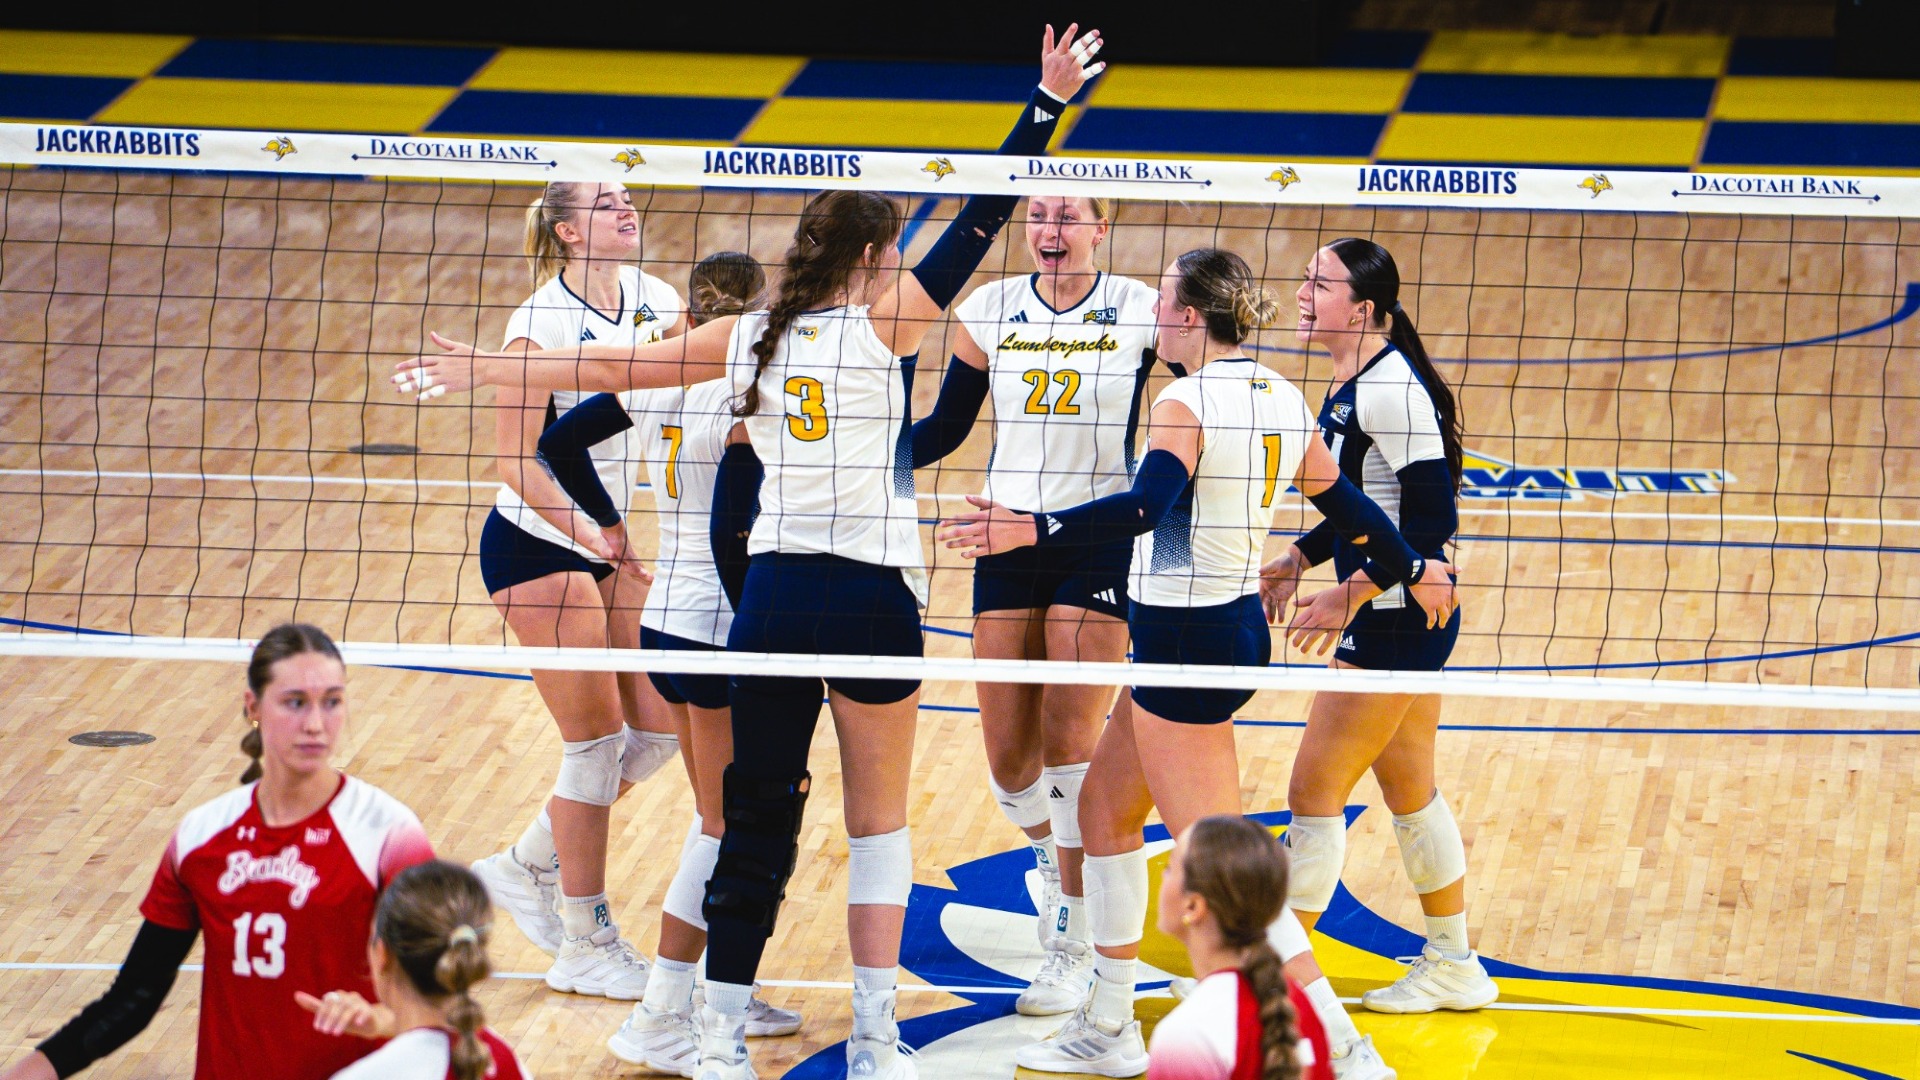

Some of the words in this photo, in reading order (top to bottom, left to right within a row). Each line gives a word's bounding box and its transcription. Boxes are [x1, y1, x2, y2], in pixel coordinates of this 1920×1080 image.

[35, 128, 201, 157] JACKRABBITS
[370, 138, 473, 159] DACOTAH
[479, 142, 539, 161] BANK
[703, 150, 862, 178] JACKRABBITS
[1027, 158, 1128, 179] DACOTAH
[1135, 162, 1194, 180] BANK
[1357, 167, 1518, 195] JACKRABBITS
[1690, 174, 1795, 193] DACOTAH
[1801, 177, 1862, 195] BANK
[996, 332, 1119, 359] Lumberjacks
[1021, 368, 1081, 415] 22
[783, 375, 830, 442] 3
[660, 423, 684, 499] 7
[1261, 432, 1282, 508] 1
[218, 845, 320, 909] Bradley
[232, 912, 287, 979] 13
